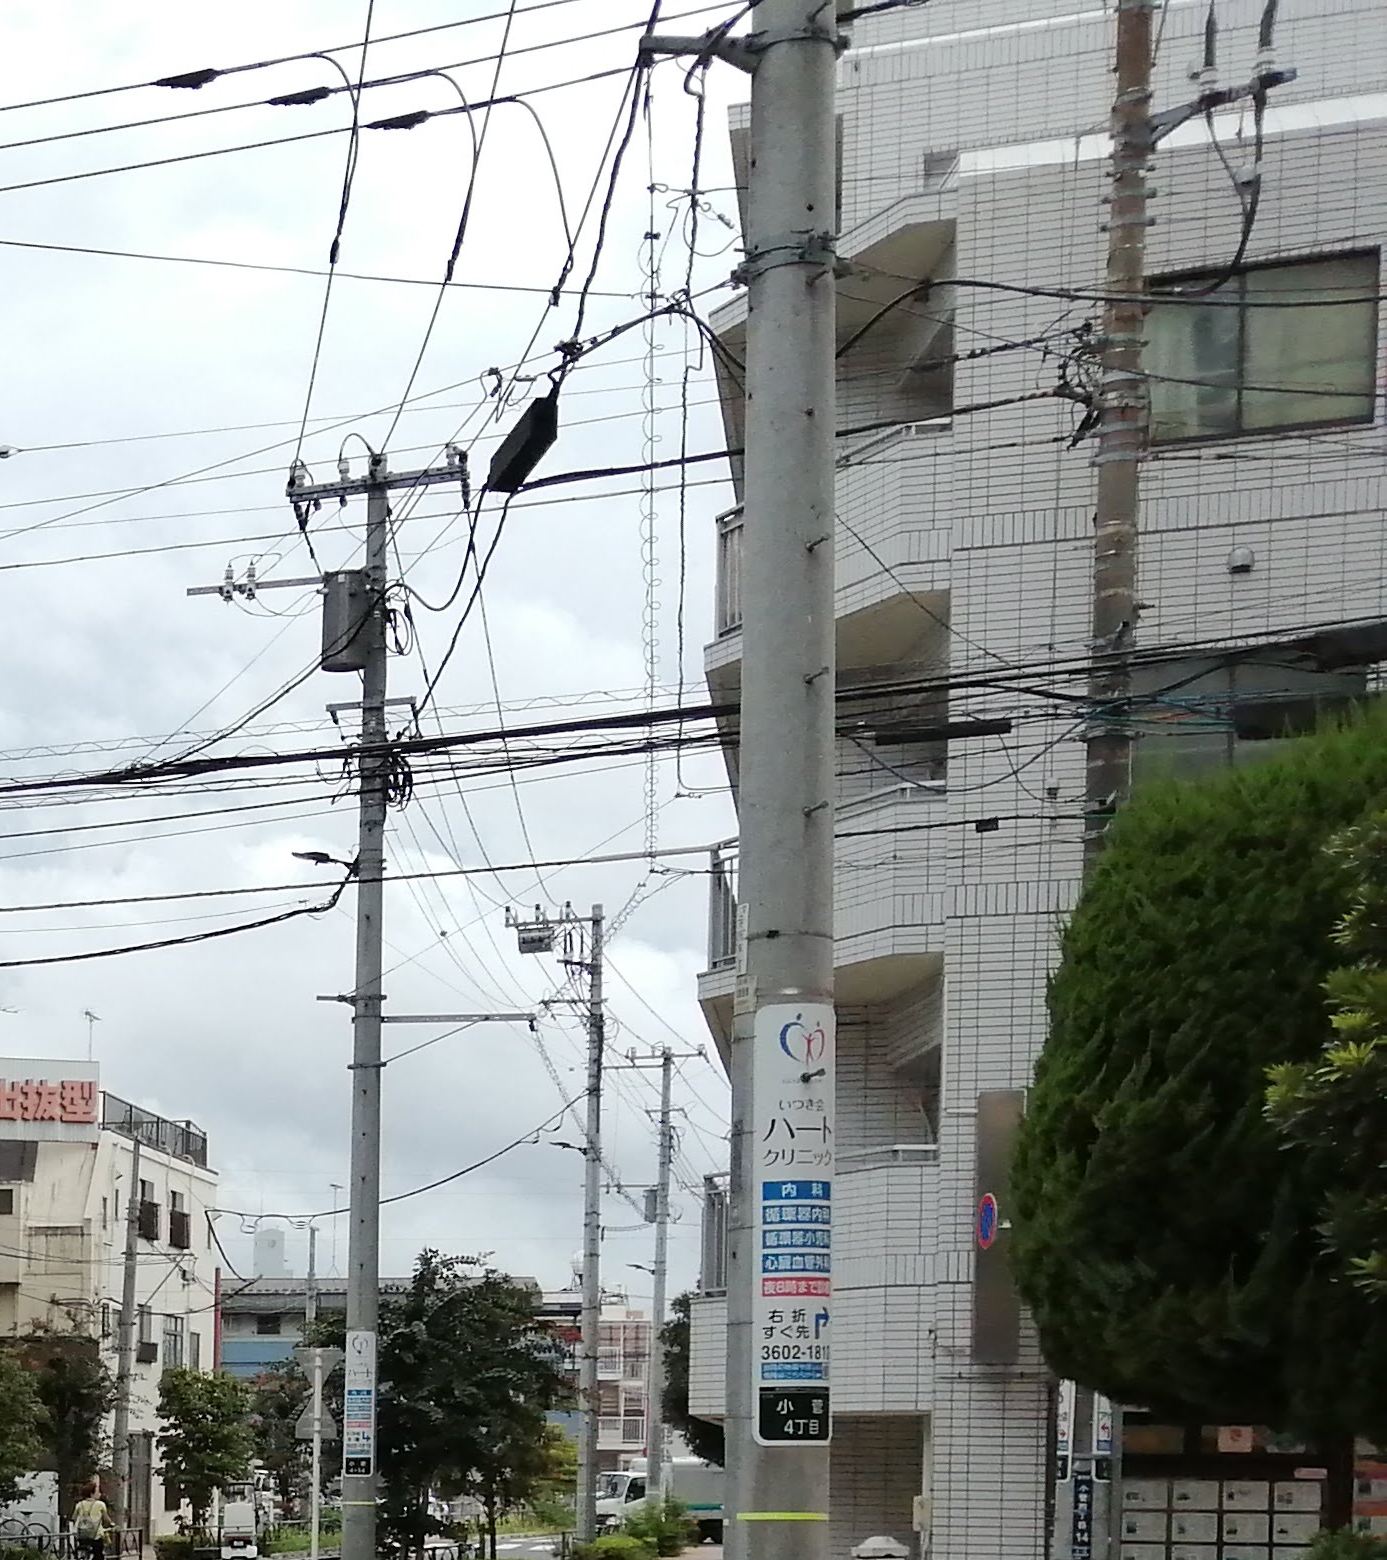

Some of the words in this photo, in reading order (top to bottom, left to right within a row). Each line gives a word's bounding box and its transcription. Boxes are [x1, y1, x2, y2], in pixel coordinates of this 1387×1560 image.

[779, 1099, 825, 1111] いつき会
[763, 1115, 832, 1143] ハート
[763, 1149, 832, 1167] クリニック
[781, 1182, 823, 1198] 内科
[768, 1308, 807, 1324] 右折
[762, 1325, 810, 1340] すぐ先
[776, 1398, 824, 1415] 小菅
